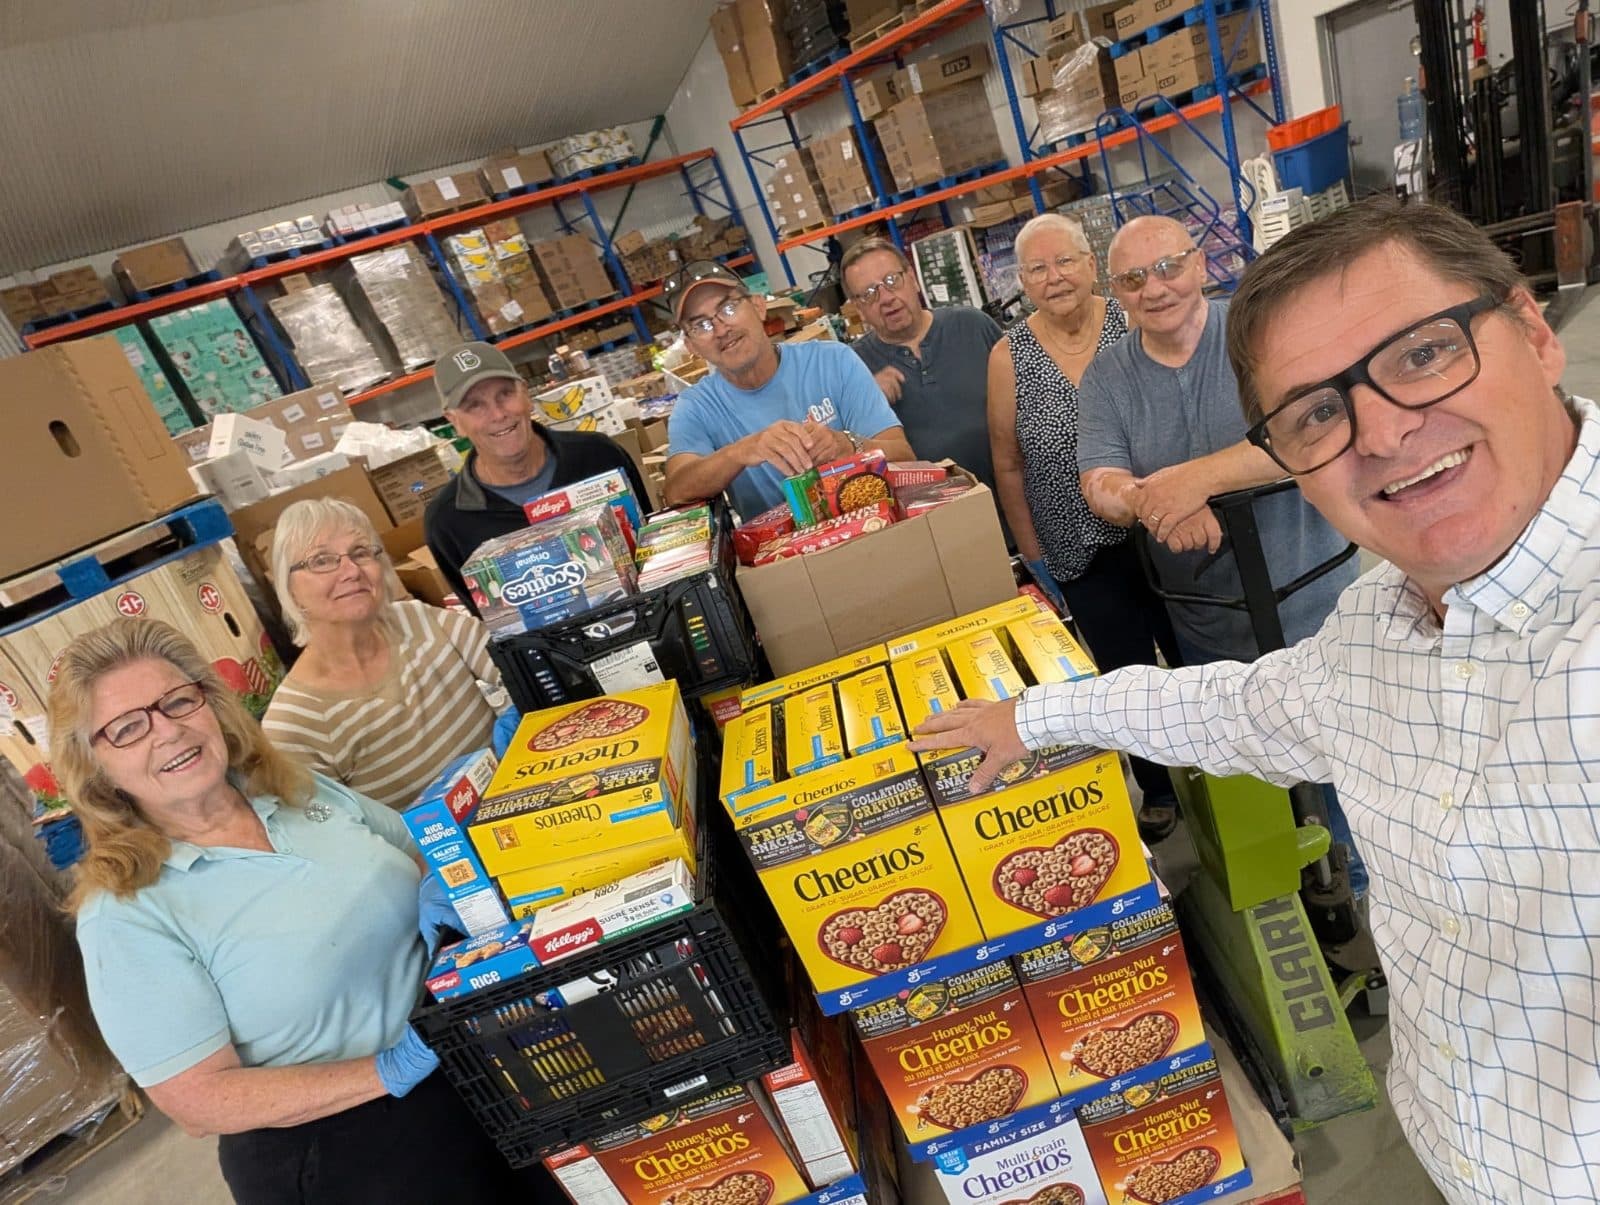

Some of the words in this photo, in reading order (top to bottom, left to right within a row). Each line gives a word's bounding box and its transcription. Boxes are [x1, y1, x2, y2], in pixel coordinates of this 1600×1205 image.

[506, 564, 582, 600] Scotties
[936, 617, 989, 638] Cheerios
[788, 669, 840, 690] Cheerios
[514, 739, 640, 780] Cheerios
[793, 776, 857, 806] Cheerios
[851, 777, 918, 807] COLLATIONS
[852, 785, 925, 819] GRATUITES
[534, 803, 602, 830] Cheerios
[975, 780, 1104, 840] Cheerios
[748, 820, 797, 845] FREE
[750, 830, 805, 855] SNACKS
[794, 842, 926, 902] Cheerios
[593, 880, 620, 900] CORN
[1111, 903, 1170, 930] COLLATIONS
[1112, 911, 1174, 940] GRATUITES
[544, 926, 595, 952] Kellogg's
[1021, 941, 1064, 963] FREE
[948, 959, 1007, 987] COLLATIONS
[1021, 950, 1070, 972] SNACKS
[1092, 965, 1131, 986] Honey
[1134, 955, 1157, 972] Nut
[469, 970, 501, 990] RICE
[948, 969, 1012, 998] GRATUITES
[1058, 966, 1169, 1018] Cheerios
[855, 998, 900, 1019] FREE
[857, 1006, 906, 1028] SNACKS
[1073, 1011, 1091, 1024] miel
[931, 1018, 971, 1042] Honey
[974, 1010, 997, 1027] Nut
[899, 1020, 1012, 1073] Cheerios
[916, 1066, 935, 1079] miel
[1160, 1059, 1217, 1086] GRATUITES
[1144, 1108, 1179, 1128] Honey
[1180, 1099, 1201, 1114] Nut
[665, 1131, 705, 1152] Honey
[706, 1123, 732, 1138] Nut
[974, 1130, 1017, 1153] FAMILY
[1020, 1121, 1047, 1137] SIZE
[1113, 1108, 1212, 1155] Cheerios
[634, 1131, 750, 1181] Cheerios
[996, 1149, 1030, 1172] Multi
[1032, 1137, 1066, 1158] Grain
[963, 1148, 1073, 1199] Cheerios
